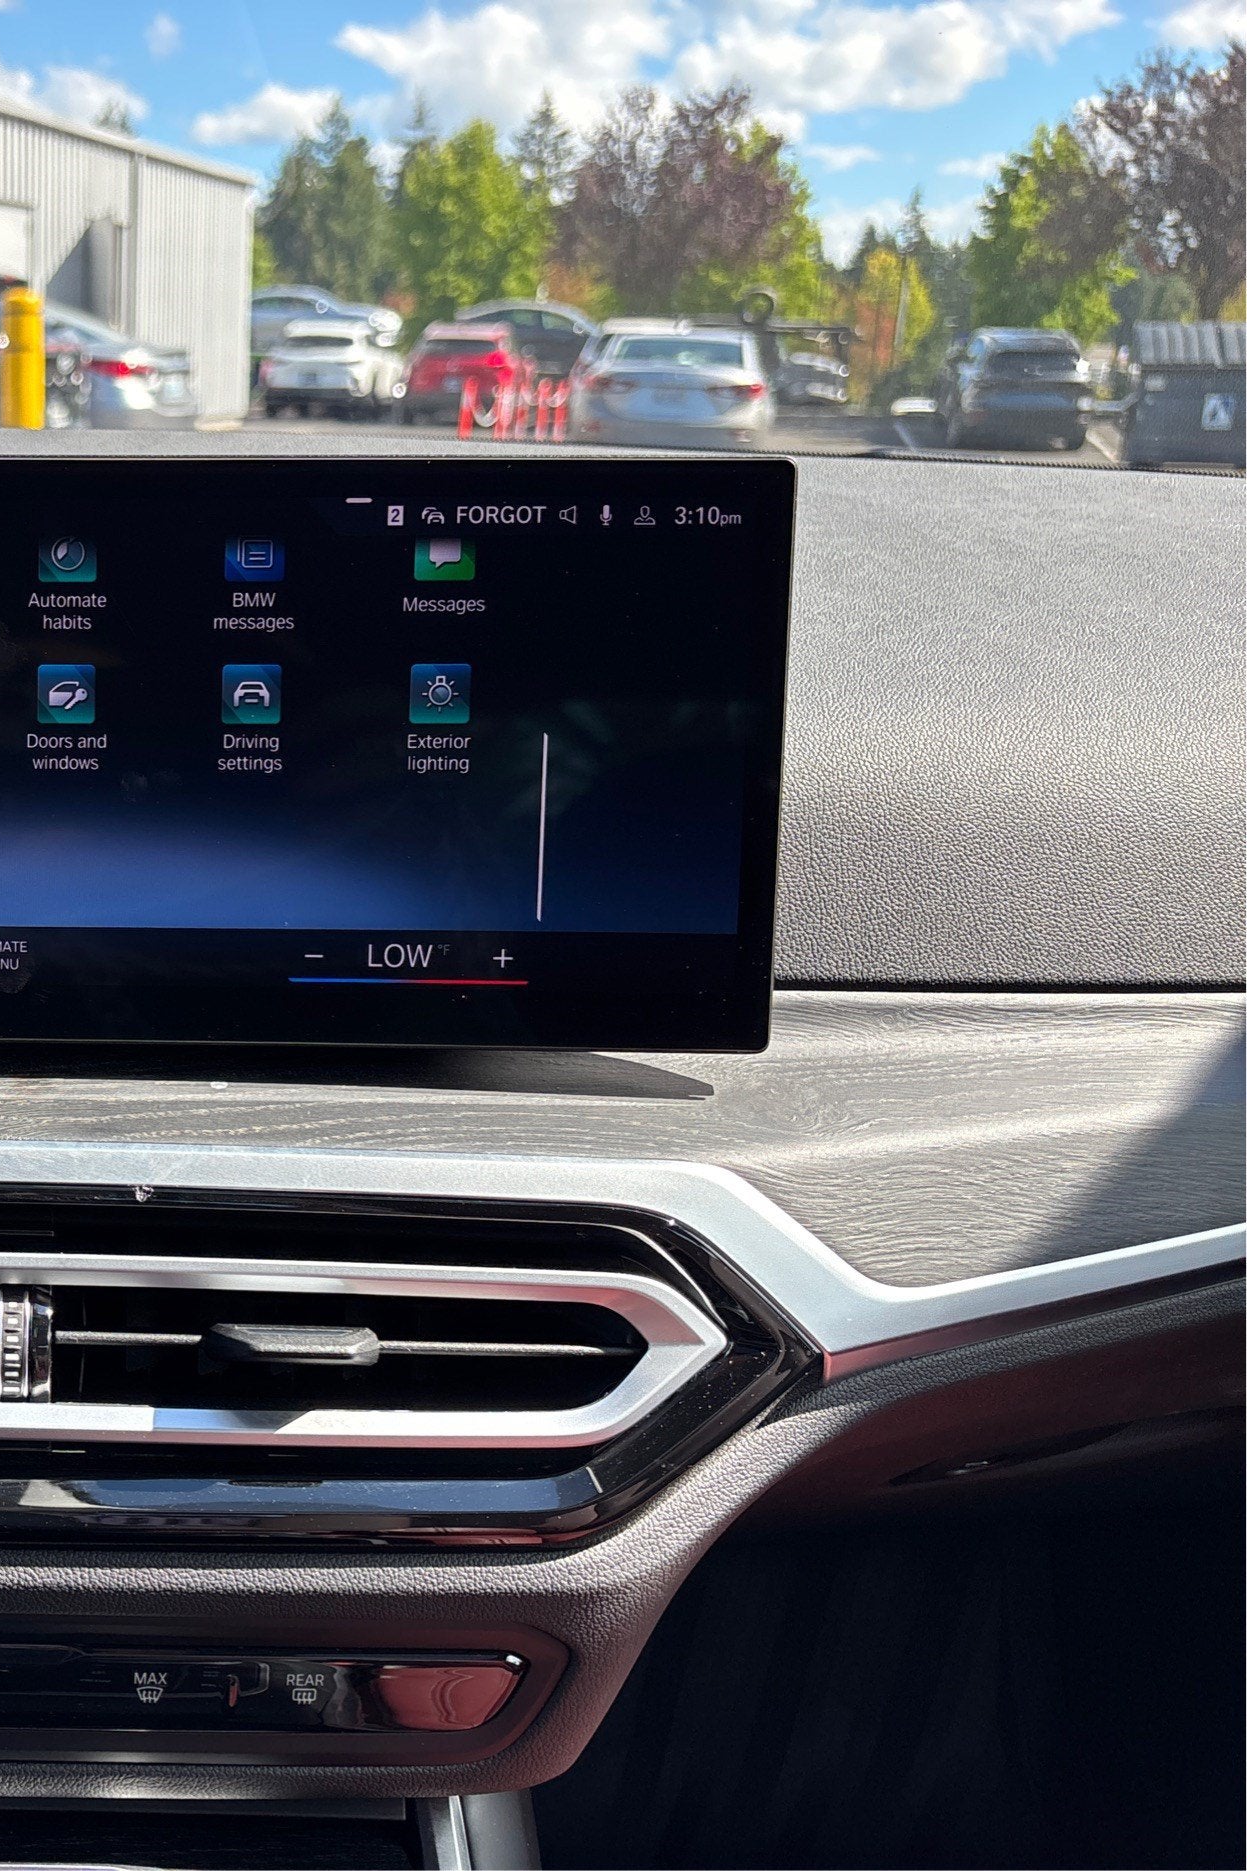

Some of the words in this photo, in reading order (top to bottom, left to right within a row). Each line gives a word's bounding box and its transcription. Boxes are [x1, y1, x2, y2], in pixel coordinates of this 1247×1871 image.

[389, 507, 402, 524] 2
[456, 505, 547, 524] FORGOT
[674, 506, 742, 527] 3:10pm
[28, 592, 107, 608] Automate
[232, 592, 276, 608] BMW
[402, 596, 486, 615] Messages
[43, 614, 92, 630] habits
[213, 617, 295, 633] messages
[26, 733, 72, 749] Doors
[77, 733, 107, 749] and
[223, 733, 280, 753] Driving
[407, 733, 471, 749] Exterior
[32, 755, 99, 771] windows
[217, 756, 283, 774] settings
[407, 755, 470, 774] lighting
[367, 943, 433, 968] LOW
[133, 1672, 168, 1685] MAX
[286, 1674, 325, 1686] REAR
